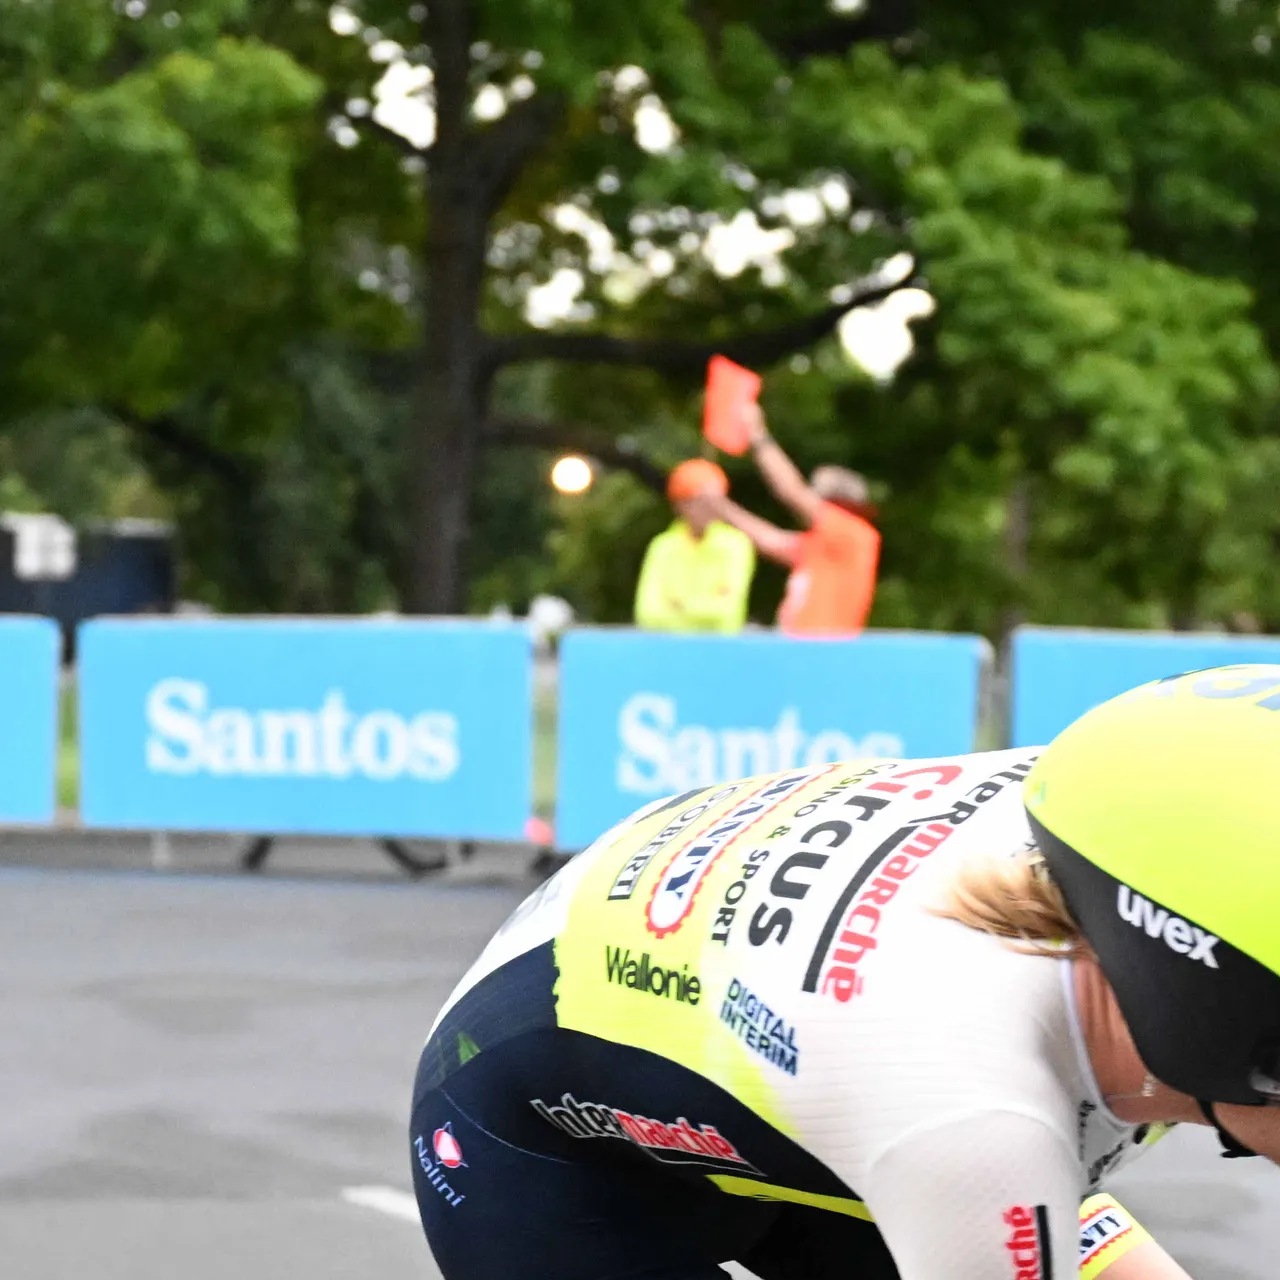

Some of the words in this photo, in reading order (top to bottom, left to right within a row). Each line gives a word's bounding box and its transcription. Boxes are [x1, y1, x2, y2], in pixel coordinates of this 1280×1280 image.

[145, 676, 460, 781] Santos
[794, 763, 898, 818] CASINO
[665, 774, 811, 899] WANTY
[748, 765, 963, 947] Circus
[766, 825, 792, 840] &
[711, 849, 770, 946] SPORT
[1116, 884, 1220, 969] uvex
[606, 945, 702, 1005] Wallonie
[720, 1001, 799, 1076] INTERIM
[727, 977, 799, 1053] DIGITAL
[414, 1136, 466, 1207] Nalini
